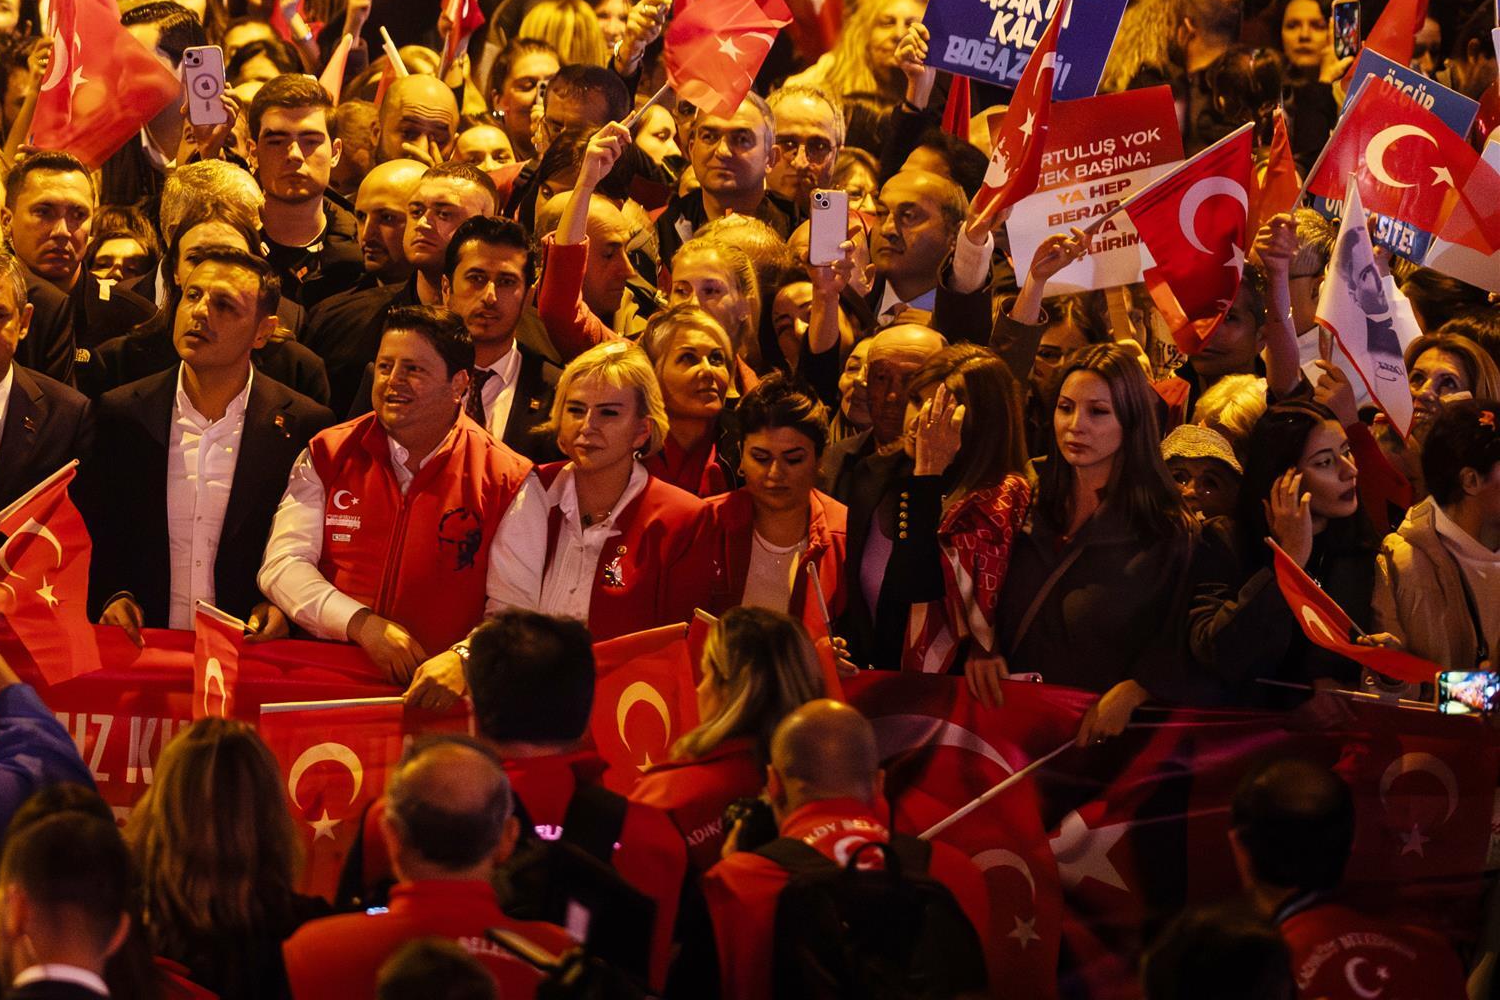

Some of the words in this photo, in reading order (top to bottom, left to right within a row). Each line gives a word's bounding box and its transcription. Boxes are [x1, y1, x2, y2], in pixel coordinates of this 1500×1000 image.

[1121, 127, 1161, 149] YOK
[1075, 151, 1152, 176] BAŞINA;
[1056, 188, 1086, 206] YA
[1090, 178, 1132, 199] HEP
